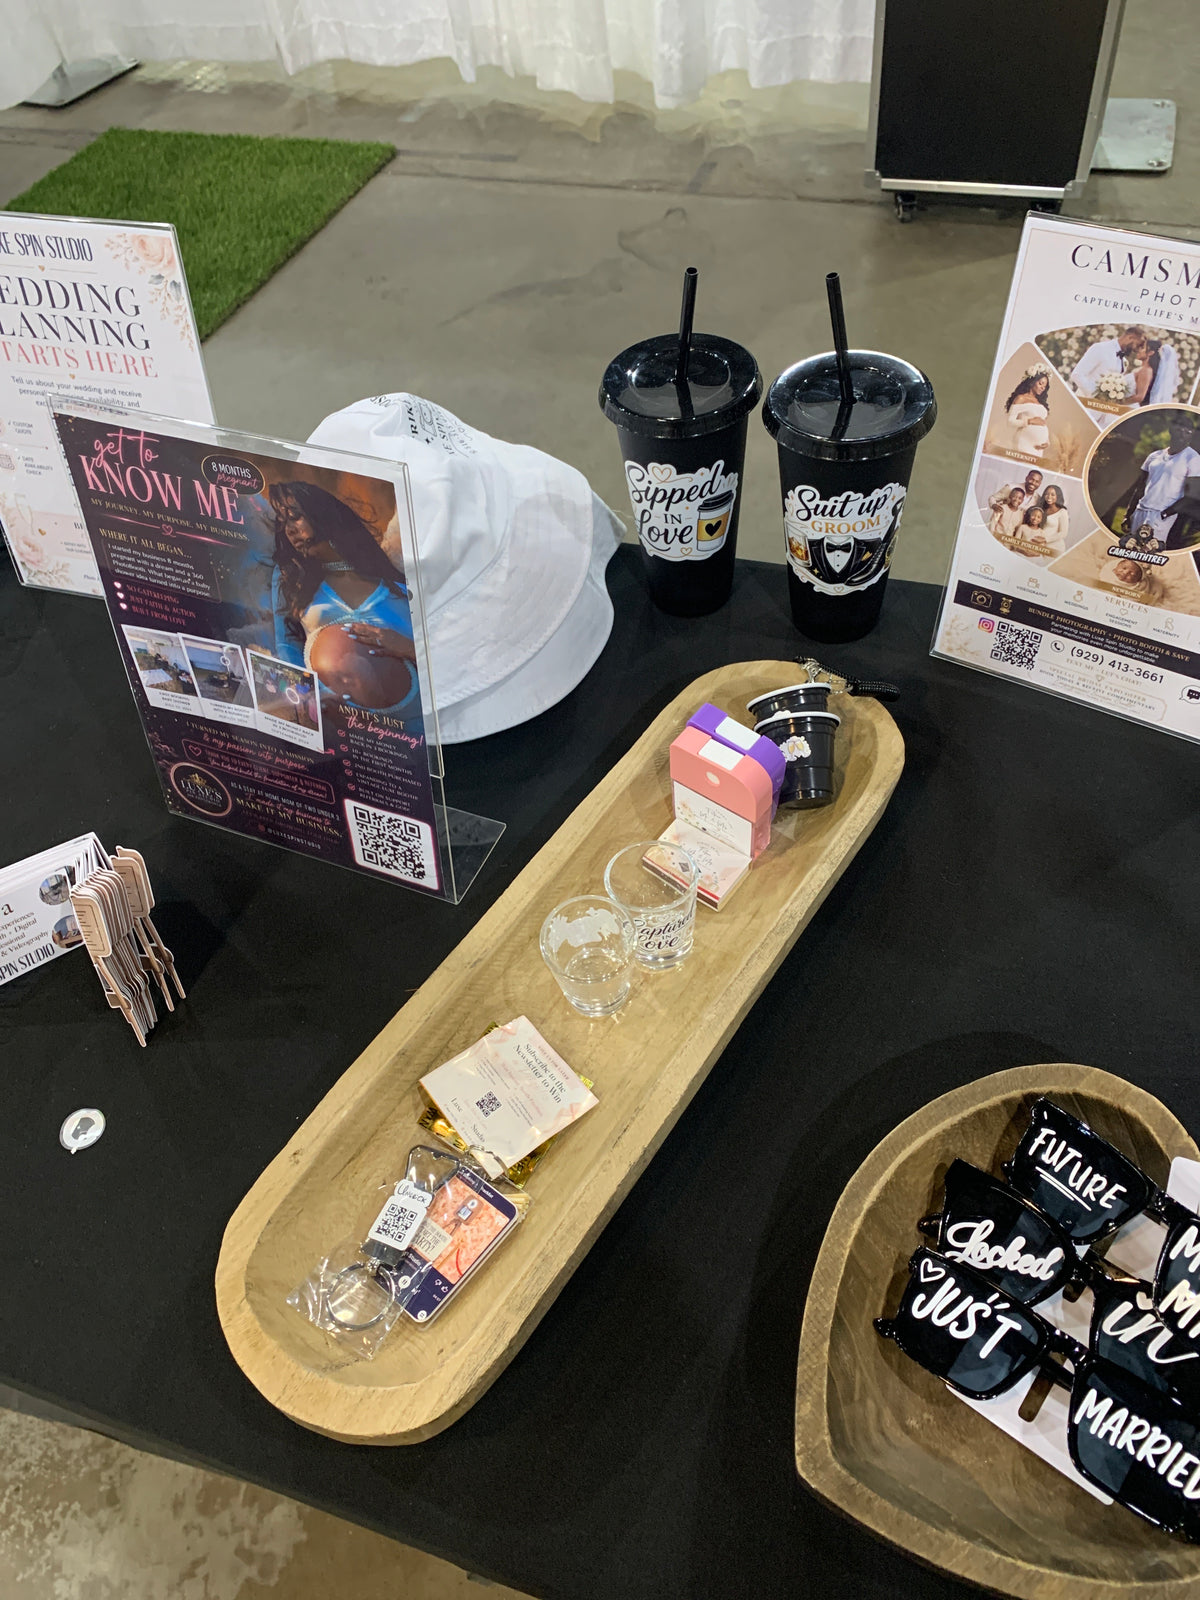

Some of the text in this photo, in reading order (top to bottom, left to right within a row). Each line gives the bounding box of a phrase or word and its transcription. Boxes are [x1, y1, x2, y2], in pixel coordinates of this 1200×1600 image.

[14, 232, 45, 257] SPIN
[45, 235, 93, 262] STUDIO
[1074, 294, 1141, 313] CAPTURING
[1147, 308, 1184, 321] LIFE'S
[1140, 288, 1197, 308] PHOT
[86, 350, 158, 378] HERE
[36, 380, 54, 388] about
[118, 390, 142, 398] receive
[1087, 400, 1120, 413] WEDDINGS
[94, 428, 160, 468] get to
[1005, 450, 1038, 463] MATERNITY
[211, 462, 252, 479] 8 MONTHS
[78, 454, 245, 525] KNOW ME
[627, 464, 722, 512] Sipped
[91, 498, 102, 506] MY
[143, 510, 155, 519] MY
[196, 522, 208, 531] MY
[796, 486, 893, 521] Suit up
[639, 509, 694, 551] Love
[664, 513, 682, 524] IN
[811, 515, 881, 534] GROOM
[99, 528, 128, 542] WHERE
[131, 536, 139, 545] IT
[141, 538, 155, 549] ALL
[1001, 536, 1051, 554] FAMILY PORTRAITS
[112, 545, 131, 553] started
[142, 551, 166, 562] business
[1108, 546, 1168, 566] CAMSMITHTREY
[1105, 595, 1149, 614] SERVICES
[1028, 607, 1055, 619] BUNDLE
[1056, 615, 1106, 636] PHOTOGRAPHY
[1113, 633, 1138, 646] PHOTO
[1139, 640, 1164, 653] BOOTH
[1172, 651, 1190, 662] SAVE
[1051, 621, 1078, 634] Partnering
[1091, 633, 1104, 641] Luxe
[1106, 637, 1117, 647] Spin
[1119, 642, 1136, 652] Studio
[1144, 650, 1159, 659] make
[1063, 630, 1089, 643] memories
[1071, 646, 1164, 684] (929) 413-3661
[338, 704, 405, 730] AND IT'S JUST
[345, 716, 423, 749] the beginning!
[1, 904, 14, 916] a
[14, 918, 37, 933] Digital
[8, 931, 48, 953] Videography
[18, 943, 55, 971] STUDIO
[513, 1044, 543, 1079] Newsletter
[549, 1086, 562, 1103] Win
[525, 1043, 550, 1074] Subscribe
[555, 1080, 566, 1093] the
[1028, 1128, 1127, 1209] FUTURE
[945, 1220, 1064, 1281] Locked
[911, 1277, 1022, 1359] JUST
